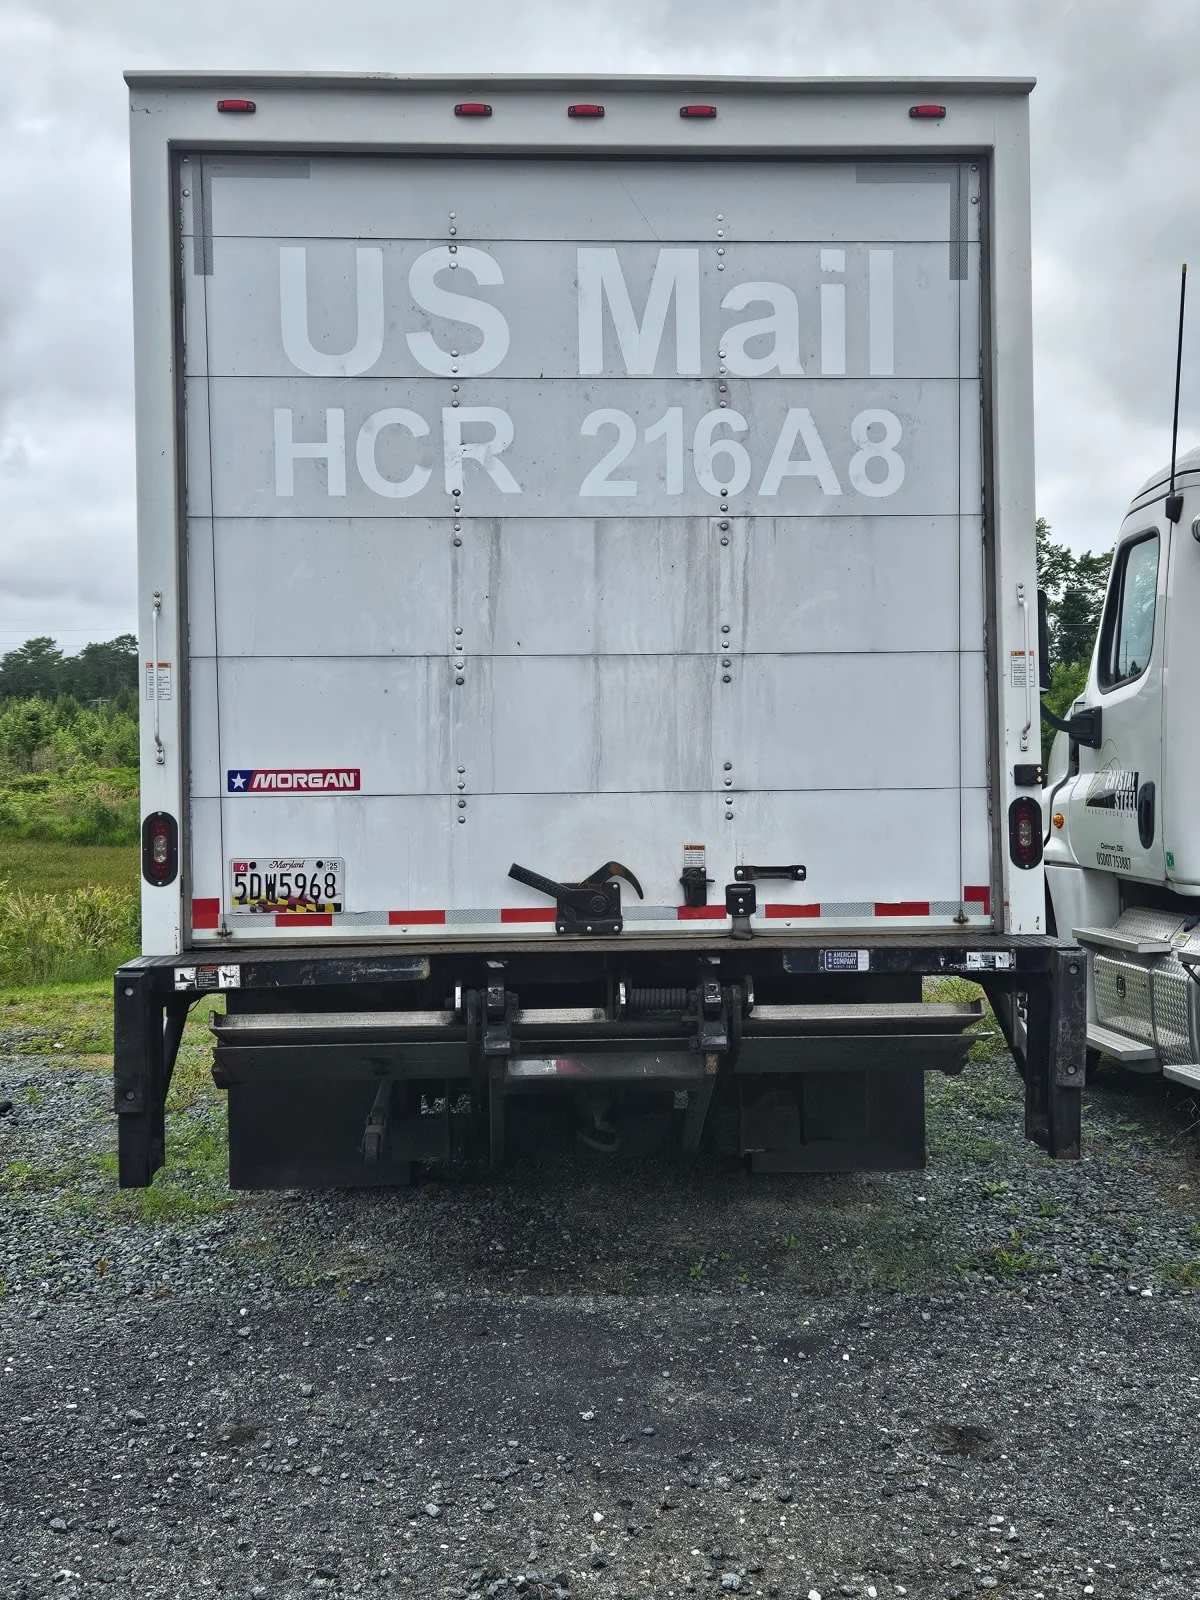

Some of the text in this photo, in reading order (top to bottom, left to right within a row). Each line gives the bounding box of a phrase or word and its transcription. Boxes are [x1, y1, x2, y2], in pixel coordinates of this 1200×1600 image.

[279, 244, 894, 378] US Mail
[273, 406, 906, 499] HCR 216A8
[252, 772, 355, 789] MORGAN
[1105, 770, 1136, 791] CRYSTAL
[1114, 790, 1138, 811] STEEL
[269, 860, 305, 871] Maryland
[234, 872, 336, 901] 5DW5968
